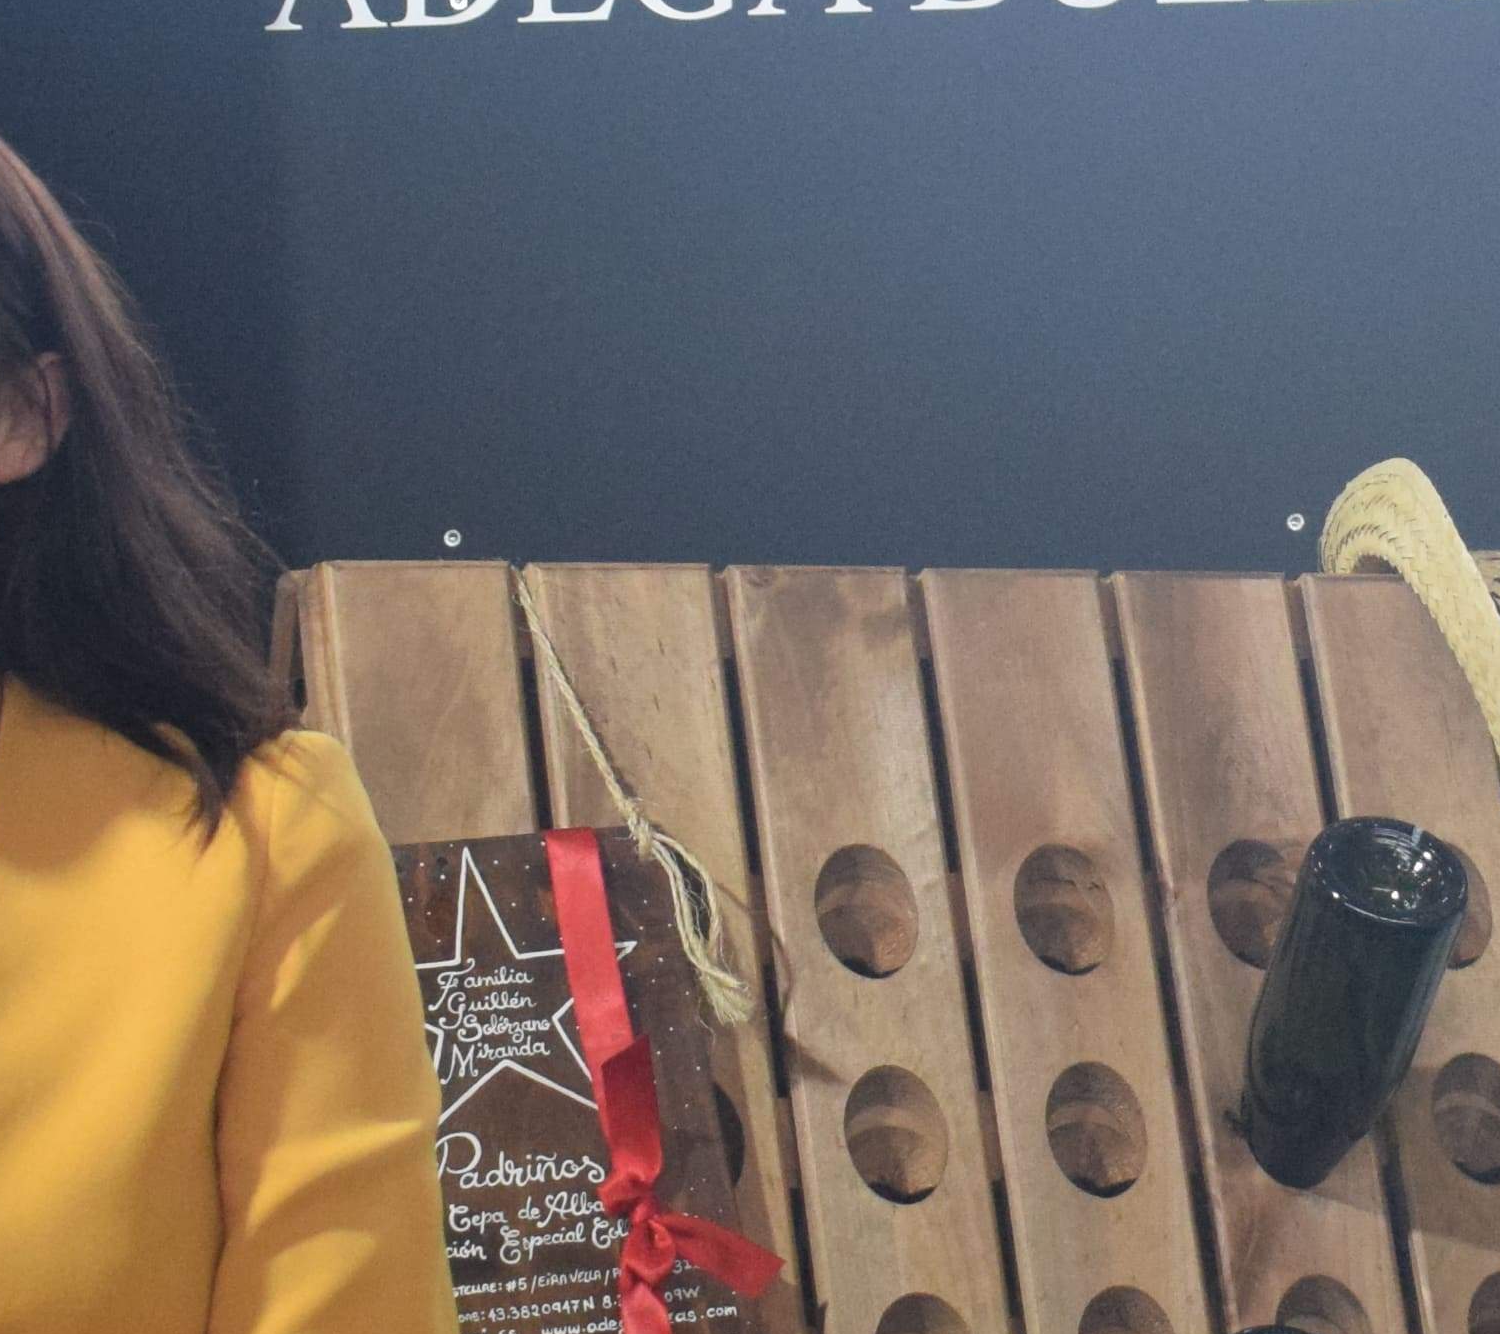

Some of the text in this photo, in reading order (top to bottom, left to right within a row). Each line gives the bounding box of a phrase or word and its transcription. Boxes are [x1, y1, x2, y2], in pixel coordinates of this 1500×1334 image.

[427, 957, 534, 1012] Familia
[438, 990, 537, 1029] Guillén
[439, 1035, 551, 1086] Miranda
[435, 1131, 606, 1190] Padriños
[518, 1196, 541, 1221] de
[499, 1222, 586, 1265] Especial
